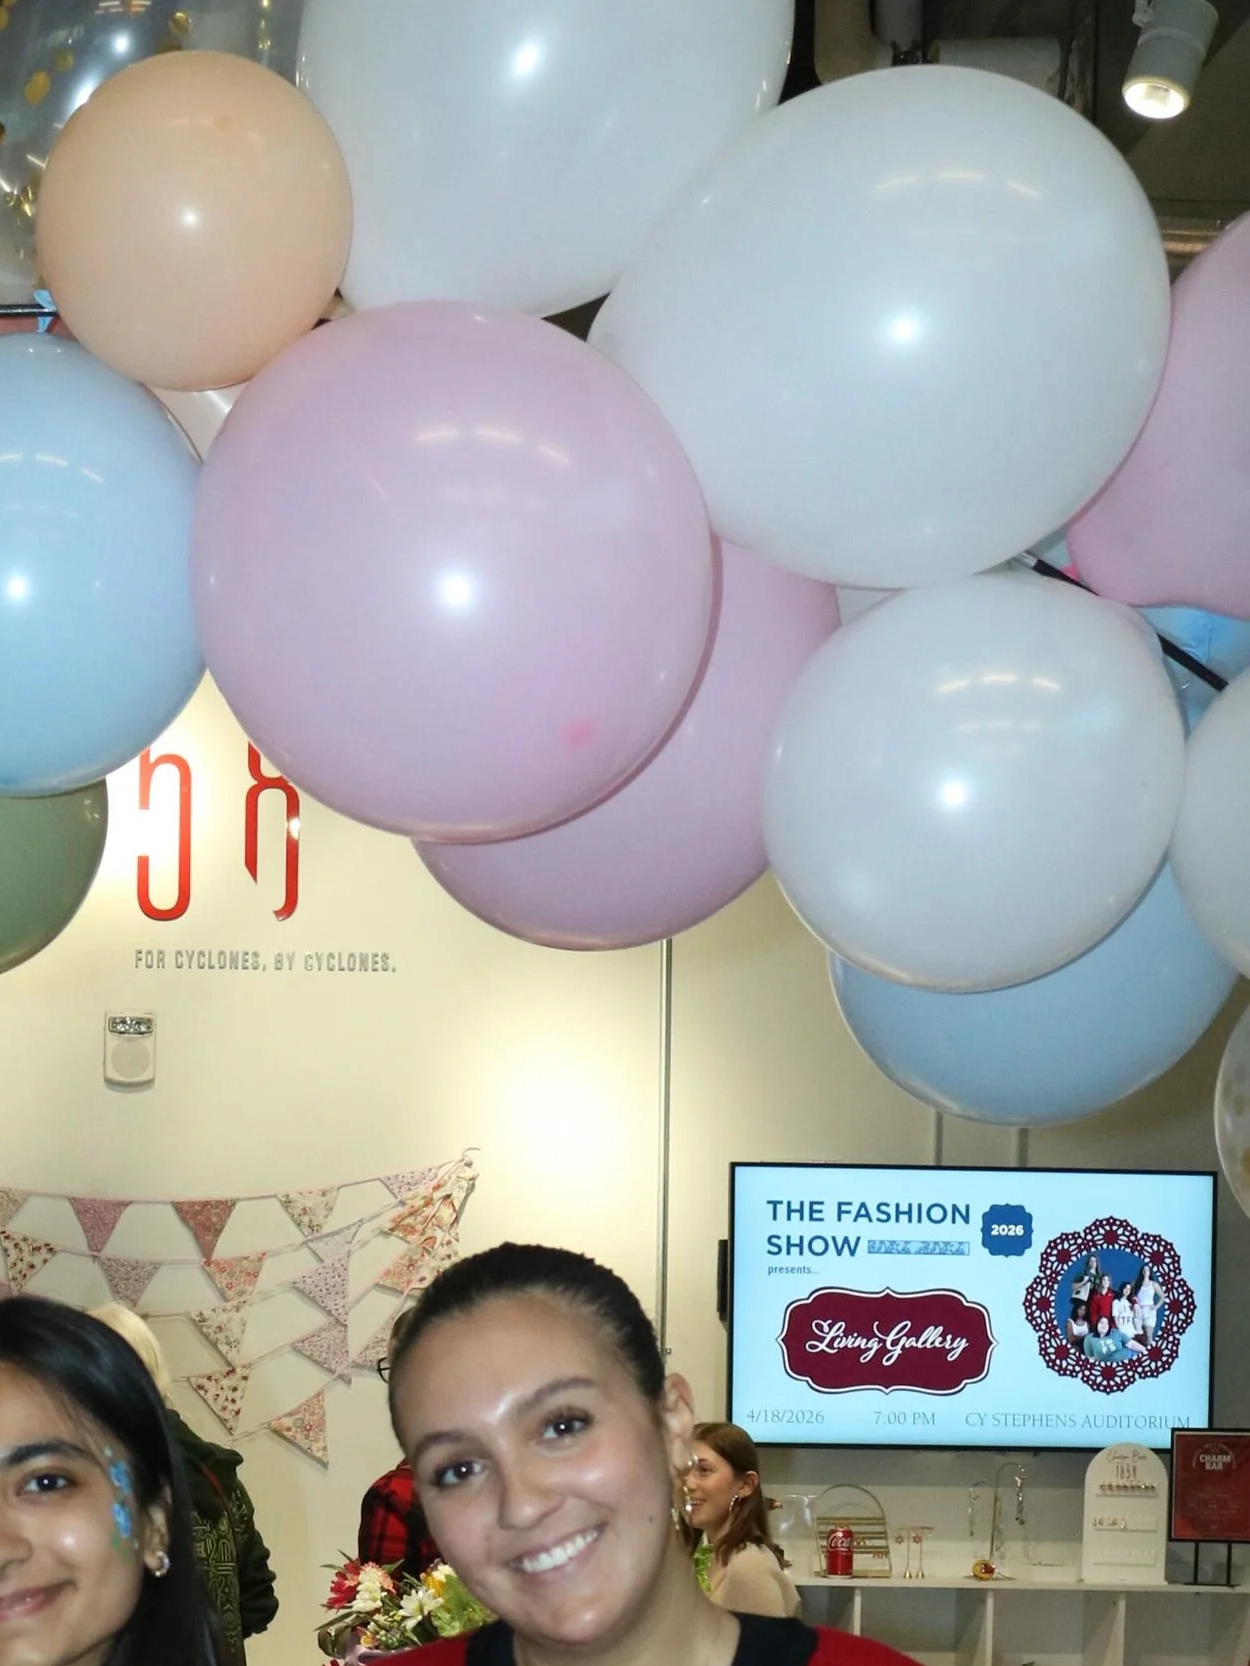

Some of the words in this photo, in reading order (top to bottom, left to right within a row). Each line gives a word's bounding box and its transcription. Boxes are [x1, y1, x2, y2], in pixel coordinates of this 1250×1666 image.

[134, 949, 166, 969] FOR
[174, 950, 267, 972] CYCLONES,
[274, 951, 296, 970] BY
[303, 952, 397, 973] CYCLONES.
[766, 1200, 825, 1223] THE
[836, 1202, 971, 1225] FASHION
[990, 1223, 1025, 1237] 2026
[766, 1234, 862, 1257] SHOW
[767, 1264, 821, 1276] presents...
[805, 1319, 882, 1363] Living
[873, 1320, 969, 1366] Gallery
[746, 1408, 825, 1425] 4/18/2026
[874, 1411, 907, 1426] 7:00
[911, 1412, 937, 1427] PM
[964, 1411, 987, 1428] CY
[992, 1412, 1077, 1429] STEPHENS
[1081, 1414, 1190, 1430] AUDITORIUM
[1200, 1454, 1231, 1463] CHARM
[1205, 1462, 1224, 1471] BAR
